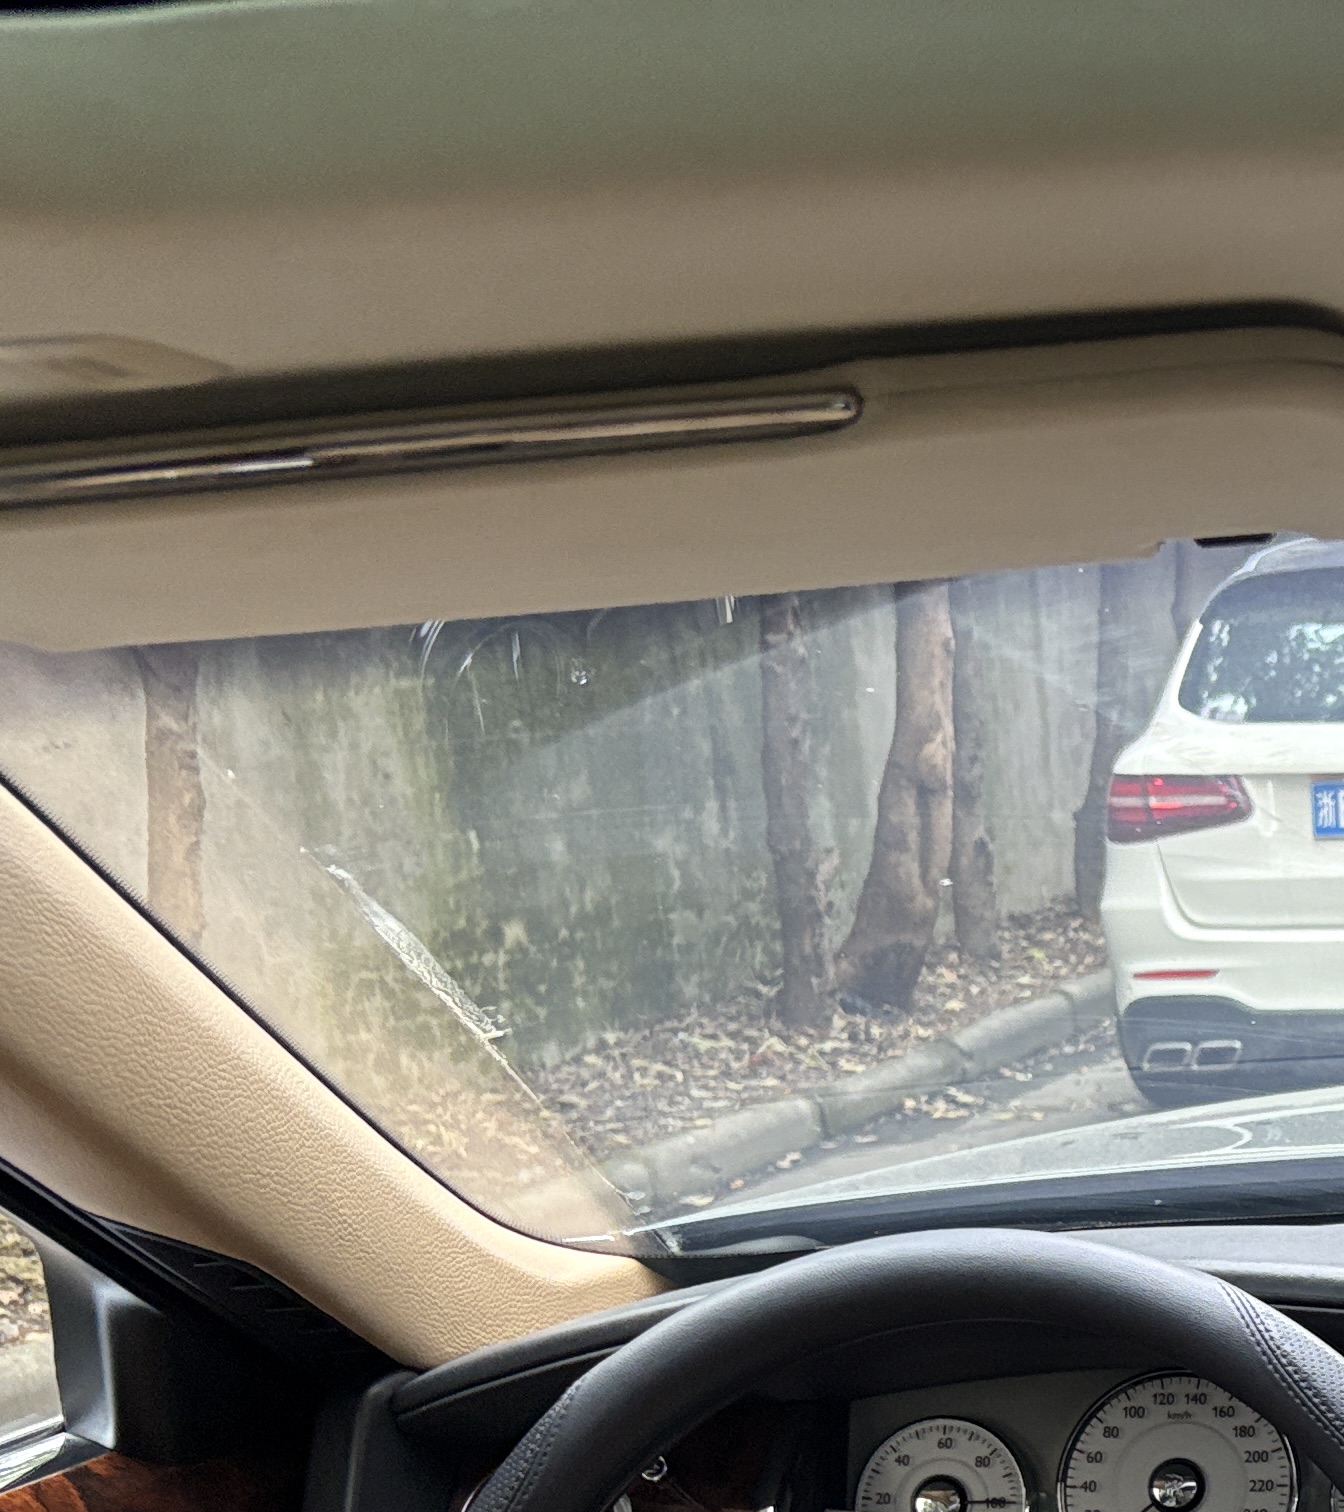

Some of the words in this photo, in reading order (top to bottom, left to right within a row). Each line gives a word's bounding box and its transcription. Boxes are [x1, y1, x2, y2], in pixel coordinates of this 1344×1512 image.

[1152, 1393, 1175, 1406] 120
[1184, 1393, 1208, 1406] 140
[1123, 1406, 1146, 1419] 100
[1167, 1410, 1192, 1420] km/h
[1212, 1406, 1236, 1419] 160
[1103, 1426, 1119, 1439] 80
[1232, 1426, 1256, 1438] 180
[937, 1437, 953, 1450] 60
[894, 1454, 910, 1467] 40
[975, 1455, 991, 1468] 80
[1086, 1451, 1103, 1464] 60
[1244, 1451, 1269, 1463] 200
[1080, 1480, 1097, 1492] 40
[1249, 1480, 1274, 1492] 220
[875, 1492, 891, 1505] 20
